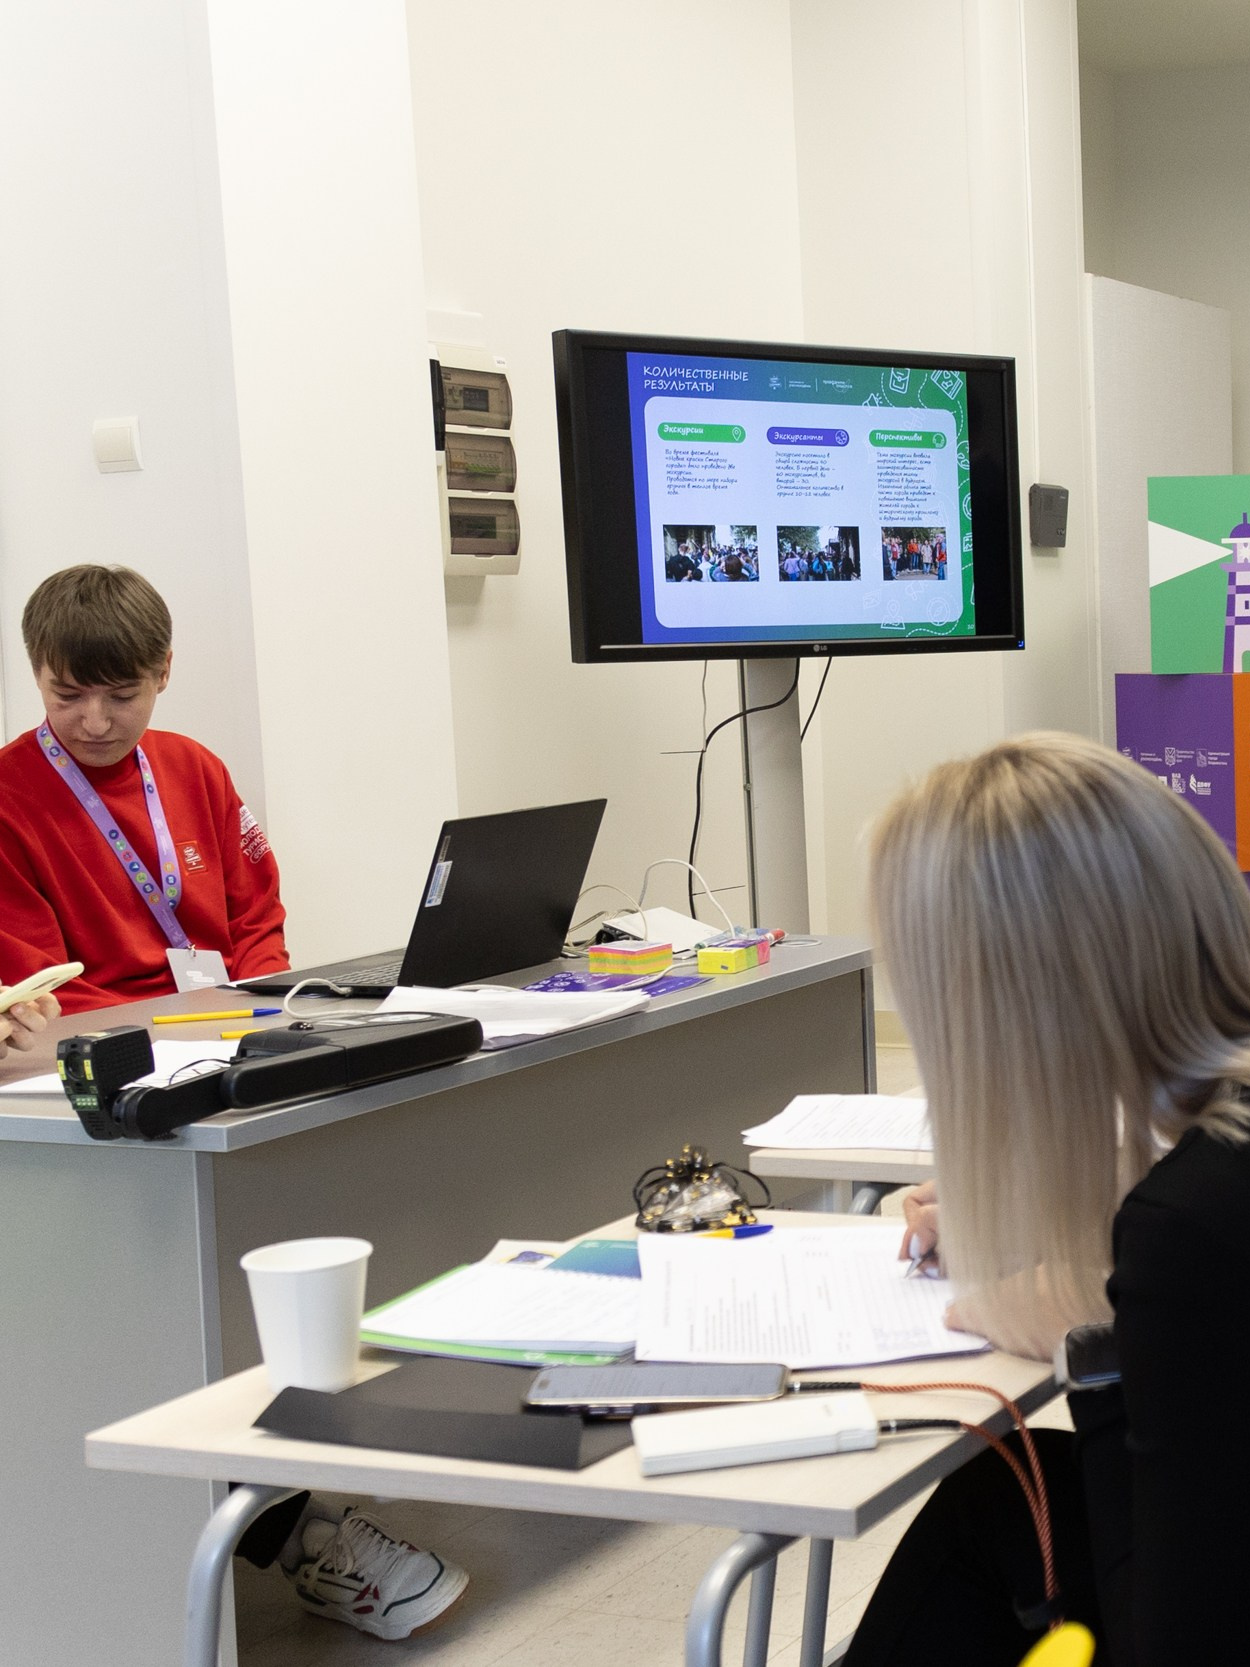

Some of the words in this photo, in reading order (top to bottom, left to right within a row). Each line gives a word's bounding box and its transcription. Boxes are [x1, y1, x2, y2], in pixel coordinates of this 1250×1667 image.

[643, 366, 749, 382] КОЛИЧЕСТВЕННЫЕ
[644, 380, 715, 392] РЕЗУЛЬТАТЫ
[663, 424, 704, 436] Экскурсии
[774, 432, 824, 442] Экскурсанты
[875, 432, 923, 442] Перспективы
